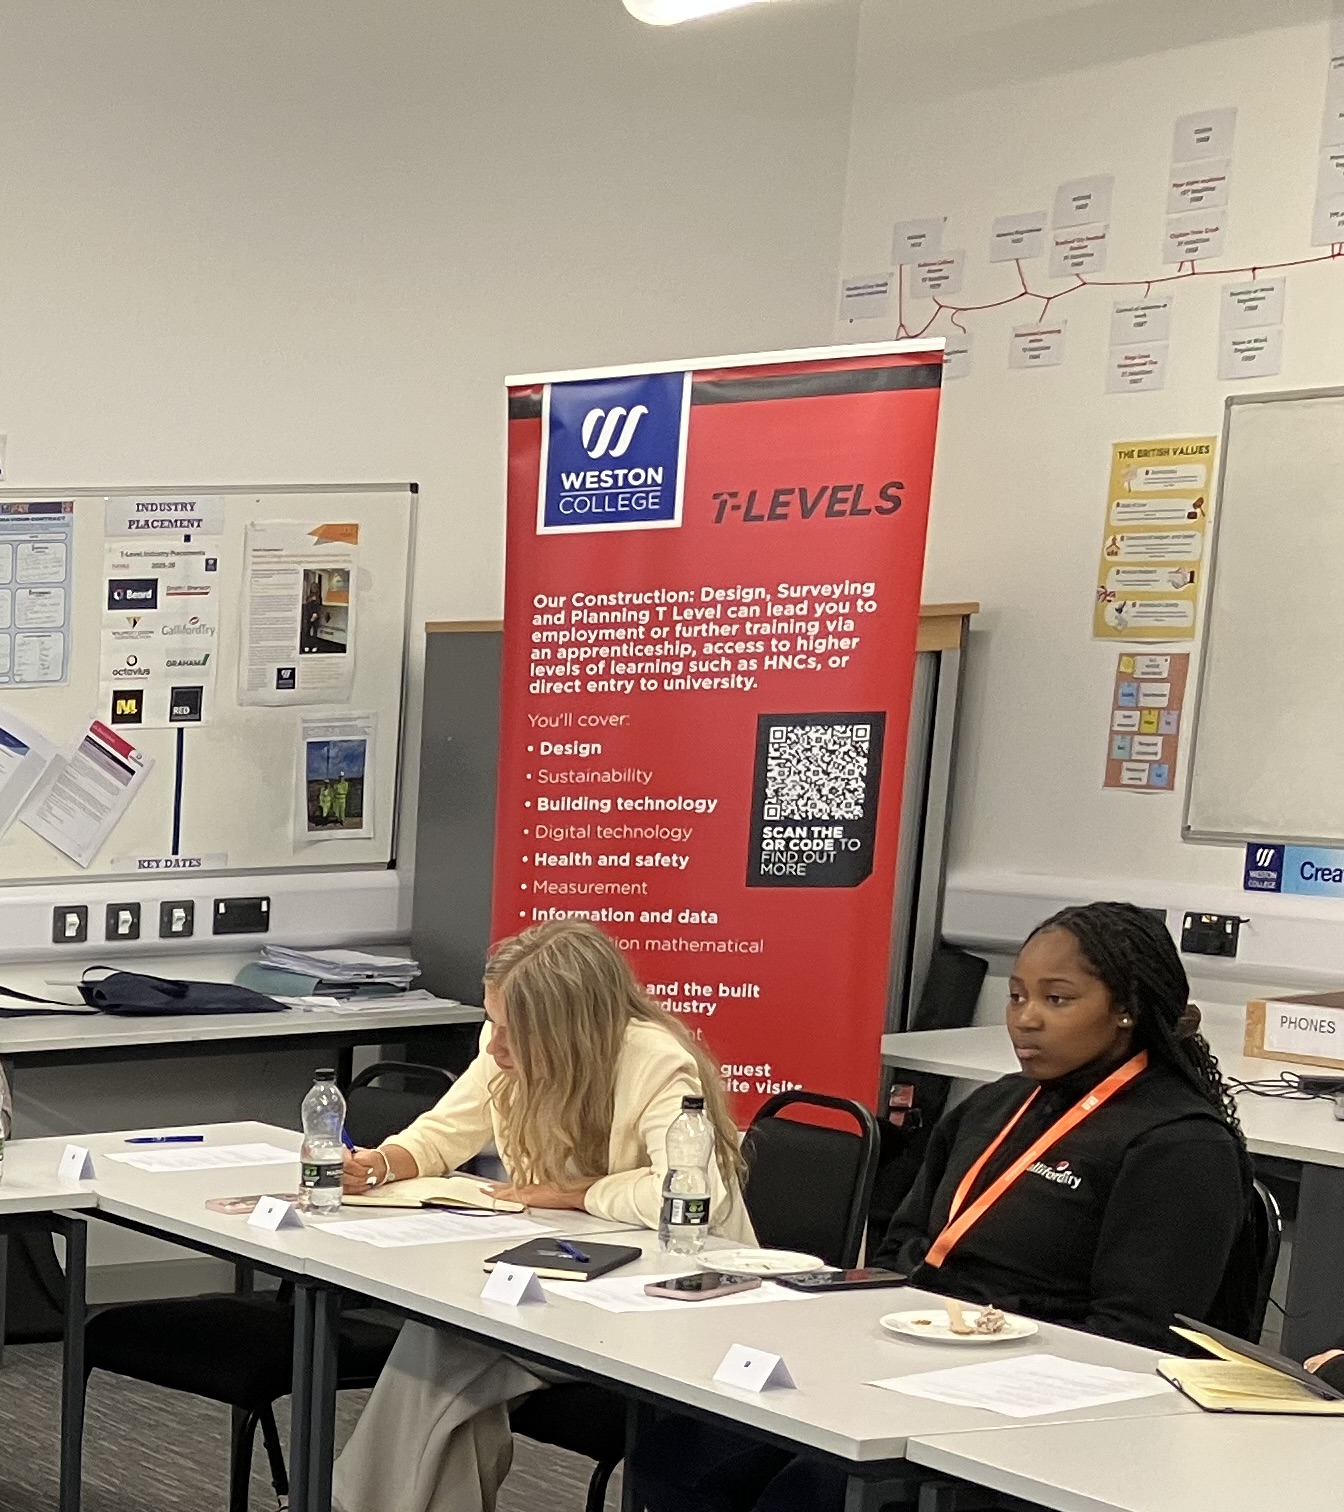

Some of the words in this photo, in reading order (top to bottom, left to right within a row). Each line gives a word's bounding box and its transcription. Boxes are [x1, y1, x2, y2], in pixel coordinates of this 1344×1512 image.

[1118, 450, 1135, 459] THE
[1137, 448, 1169, 459] BRITISH
[1172, 445, 1210, 457] VALUES
[561, 467, 664, 491] WESTON
[135, 503, 196, 513] INDUSTRY
[558, 492, 661, 515] COLLEGE
[711, 481, 905, 524] T-LEVELS
[128, 519, 203, 529] PLACEMENT
[533, 594, 566, 608] Our
[572, 589, 694, 607] Construction:
[701, 585, 771, 602] Design,
[777, 580, 875, 598] Surveying
[532, 611, 565, 626] and
[571, 607, 650, 625] Planning
[656, 607, 667, 621] T
[672, 605, 722, 621] Level
[727, 605, 760, 618] can
[767, 600, 808, 616] lead
[814, 601, 850, 617] you
[856, 599, 877, 613] to
[531, 625, 645, 644] employment
[650, 627, 670, 639] or
[675, 622, 740, 638] further
[745, 617, 820, 635] training
[826, 616, 855, 632] via
[530, 648, 551, 660] an
[556, 641, 697, 662] apprenticeship,
[703, 640, 764, 655] access
[771, 638, 790, 652] to
[796, 635, 860, 653] higher
[530, 660, 580, 677] levels
[585, 660, 606, 676] of
[610, 659, 683, 676] learning
[689, 657, 732, 672] such
[737, 658, 758, 671] as
[764, 654, 822, 671] HNCs,
[828, 655, 849, 668] or
[529, 678, 581, 694] direct
[587, 677, 634, 694] entry
[640, 677, 658, 691] to
[663, 674, 758, 692] university.
[527, 713, 572, 728] You'll
[577, 714, 631, 727] cover:
[540, 740, 602, 757] Design
[537, 768, 653, 785] Sustainability
[537, 796, 611, 813] Building
[617, 796, 718, 813] technology
[535, 824, 591, 841] Digital
[596, 824, 693, 842] technology
[762, 826, 808, 838] SCAN
[811, 826, 844, 838] THE
[761, 839, 786, 851] QR
[788, 839, 834, 851] CODE
[838, 839, 861, 851] TO
[137, 858, 160, 869] KEY
[164, 857, 202, 868] DATES
[534, 852, 592, 867] Health
[597, 852, 630, 867] and
[635, 852, 690, 869] safety
[760, 851, 799, 863] FIND
[802, 851, 837, 863] OUT
[759, 863, 807, 876] MORE
[1300, 861, 1344, 883] Crea
[533, 880, 648, 895] Measurement
[532, 907, 635, 923] Information
[640, 908, 673, 923] and
[678, 909, 719, 924] data
[645, 937, 764, 953] mathematical
[646, 981, 678, 996] and
[683, 982, 713, 997] the
[718, 983, 760, 998] built
[1280, 1015, 1337, 1034] PHONES
[720, 1063, 772, 1078] guest
